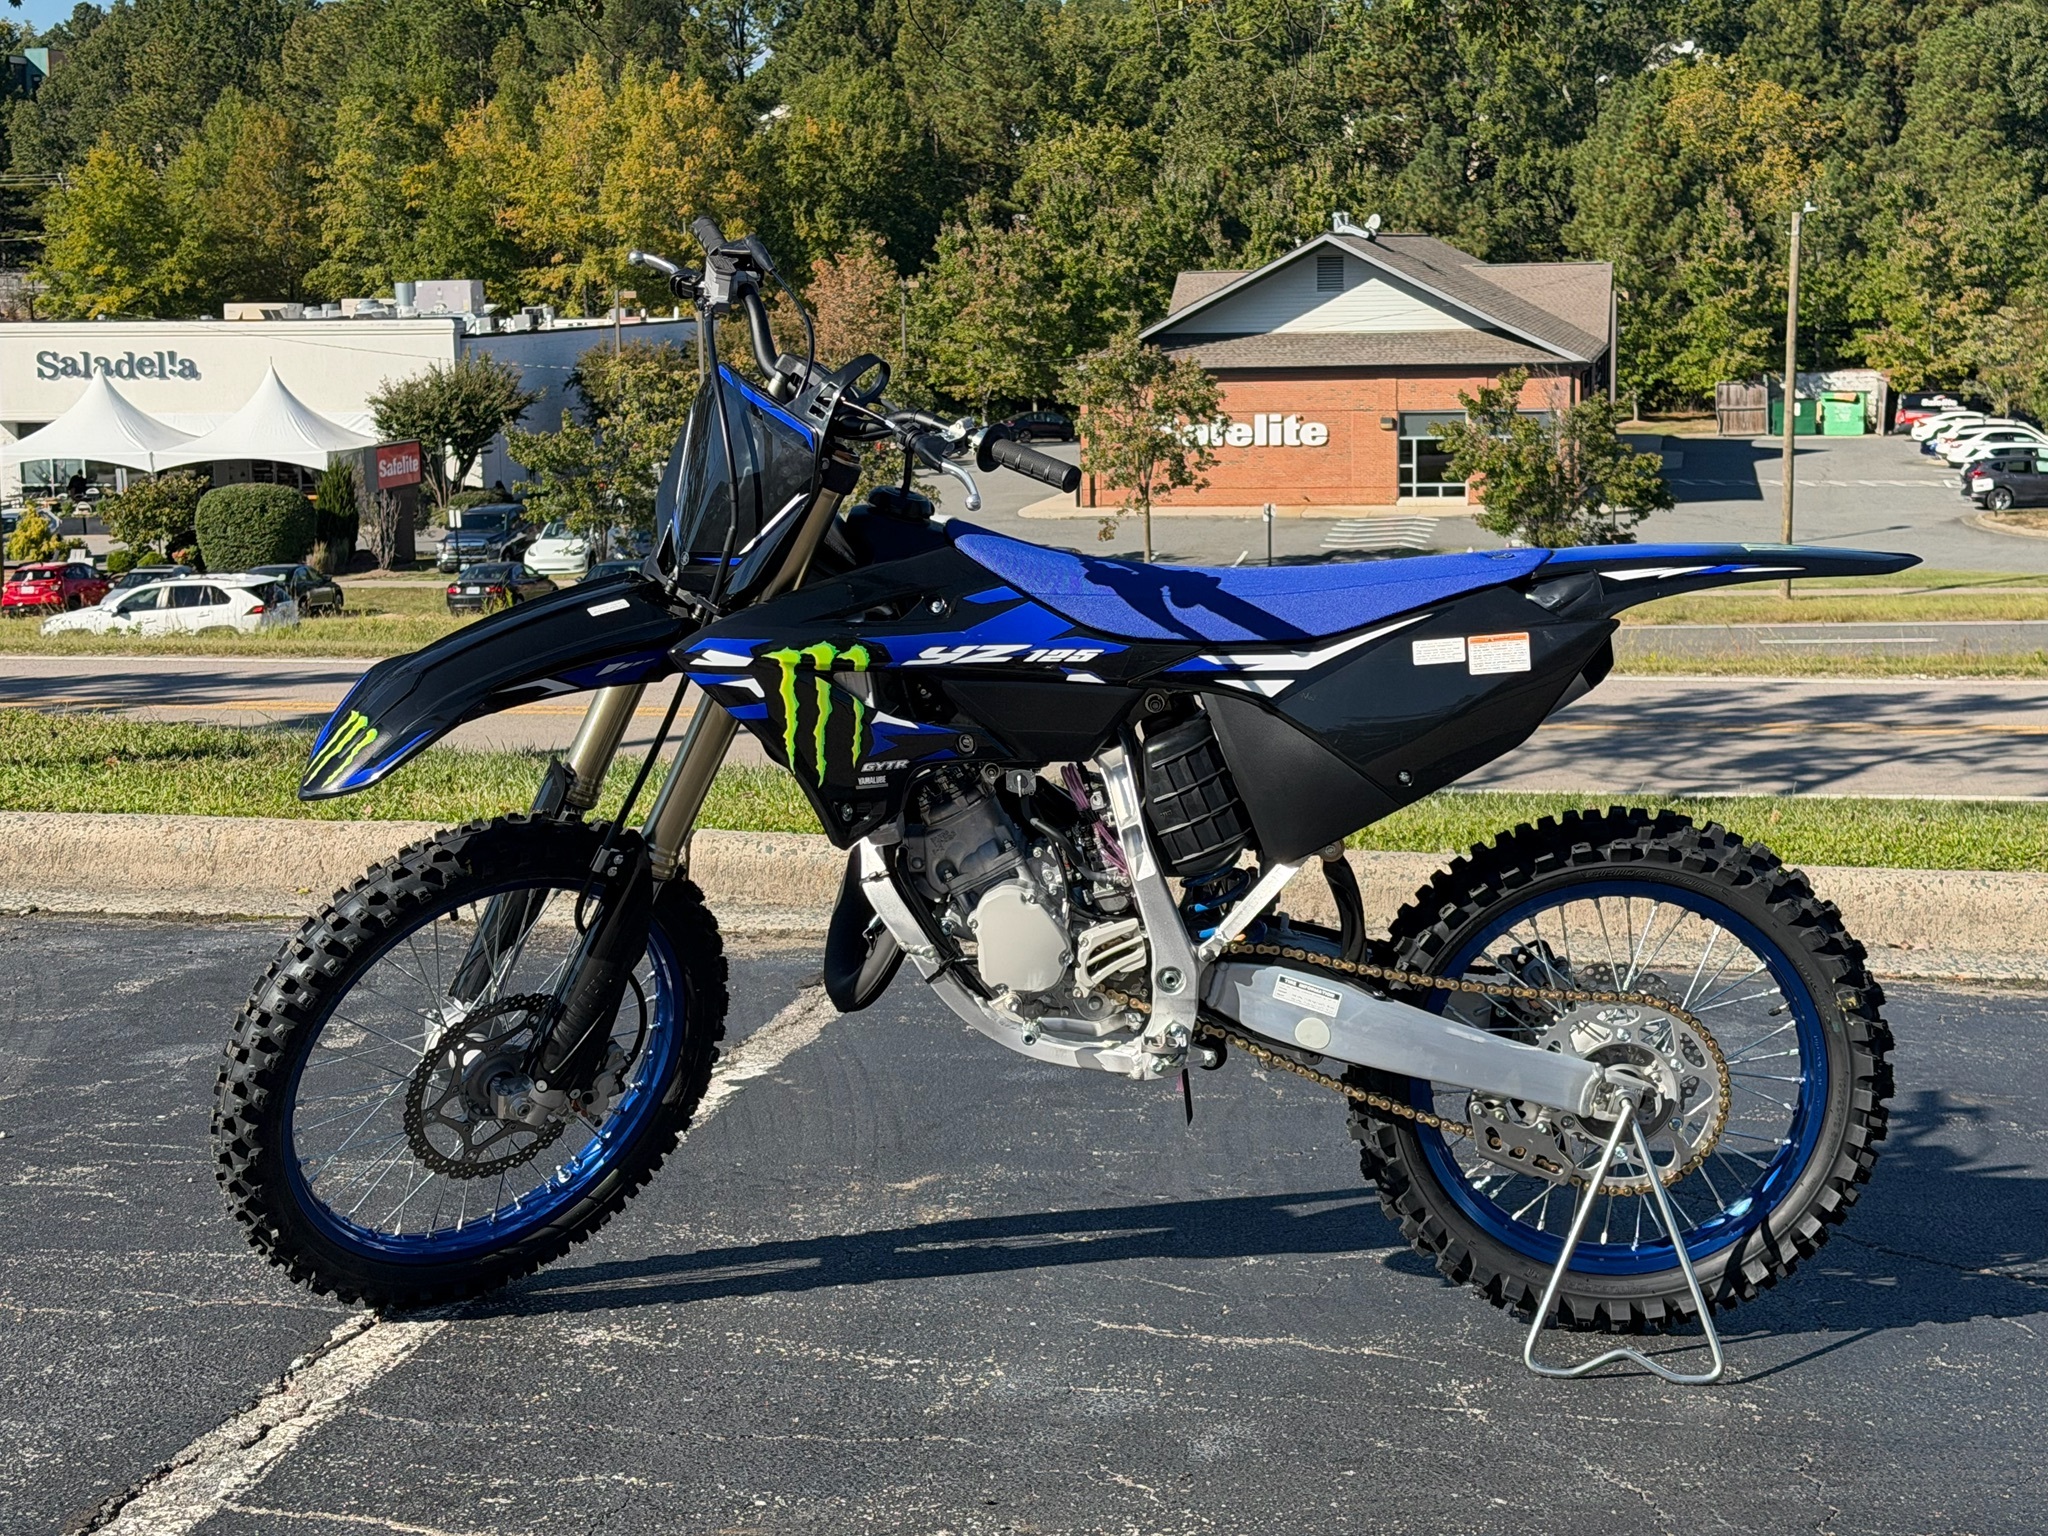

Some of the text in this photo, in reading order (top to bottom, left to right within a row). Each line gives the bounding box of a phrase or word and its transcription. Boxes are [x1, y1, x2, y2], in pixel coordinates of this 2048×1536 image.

[1160, 413, 1328, 447] afelite
[378, 455, 419, 478] Safelite
[901, 644, 1105, 666] YZ 125
[860, 759, 910, 773] GYTR
